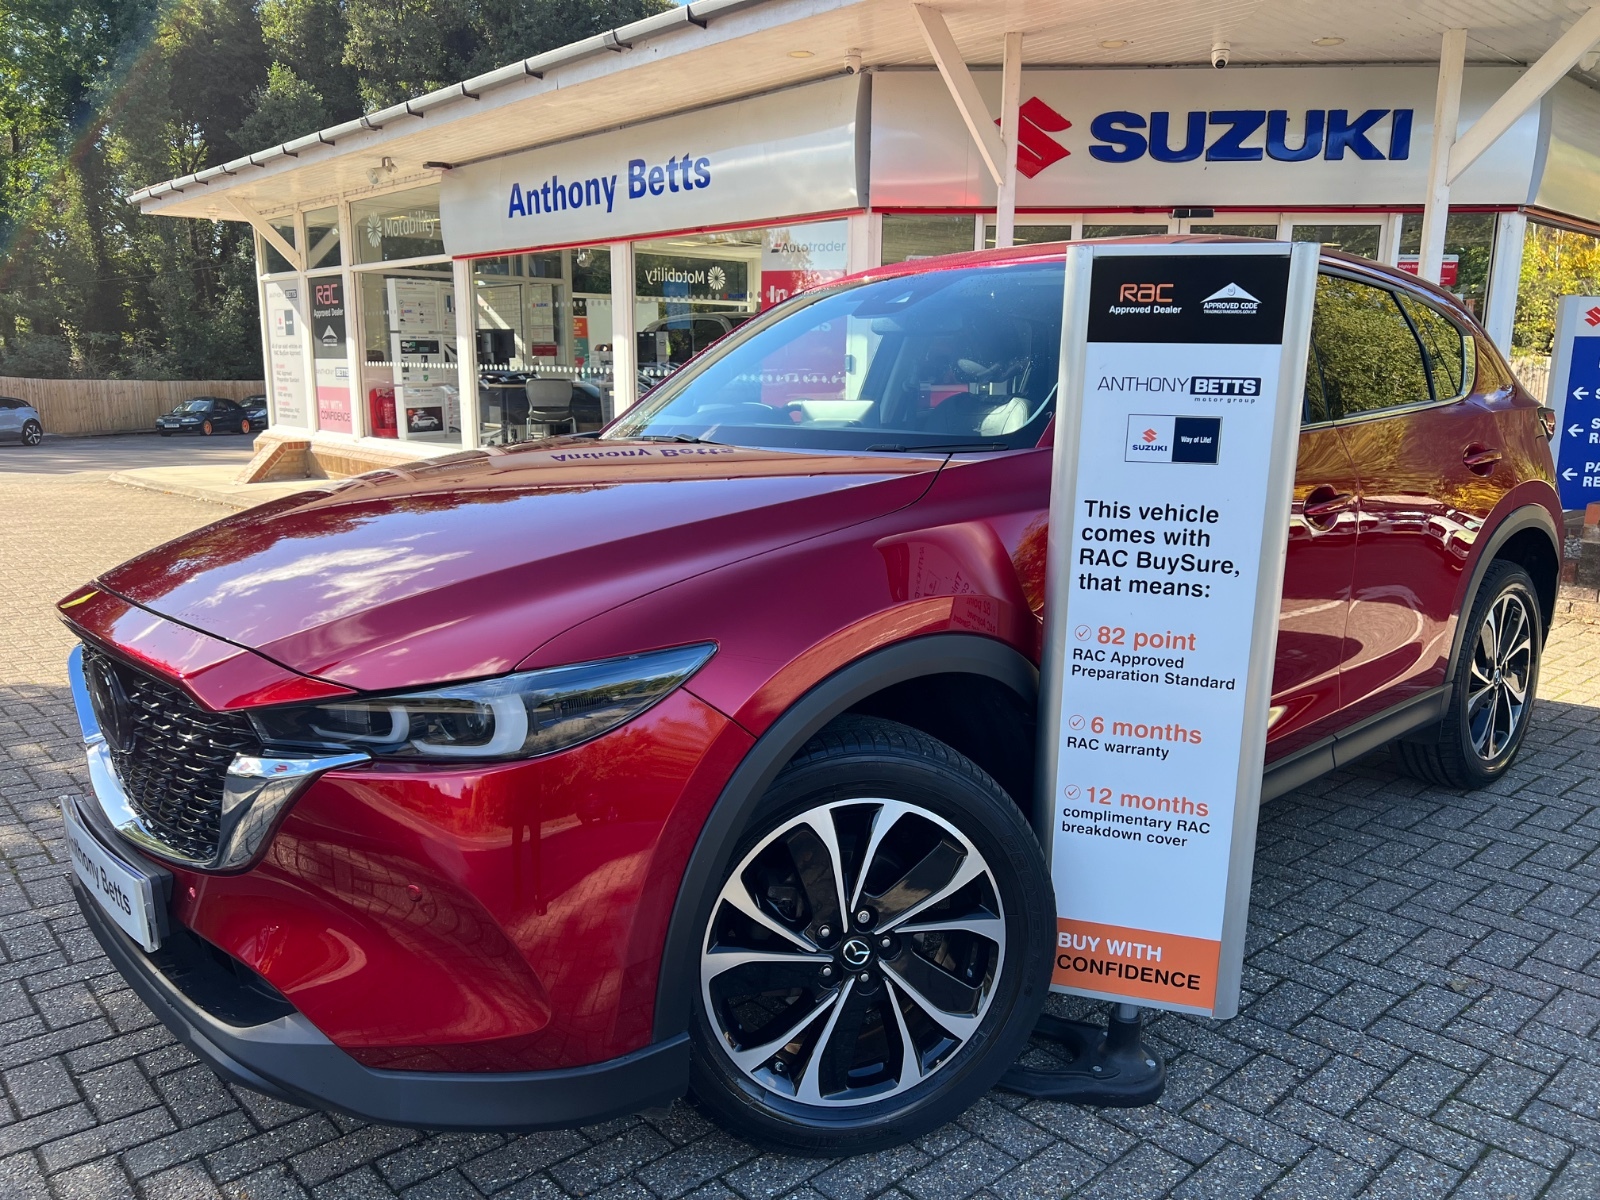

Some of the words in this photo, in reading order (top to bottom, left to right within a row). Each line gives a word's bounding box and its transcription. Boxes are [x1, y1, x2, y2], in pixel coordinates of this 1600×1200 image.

[1089, 108, 1413, 163] SUZUKI
[508, 175, 617, 218] Anthony
[628, 152, 711, 199] Betts
[384, 210, 436, 238] Motability
[781, 241, 846, 253] Autotrader
[1119, 284, 1174, 303] RAC
[1109, 305, 1150, 315] Approved
[1153, 305, 1182, 314] Dealer
[1097, 376, 1189, 392] ANTHONY
[1194, 379, 1257, 394] BETTS
[1180, 436, 1192, 444] Way
[1589, 432, 1600, 444] R
[1084, 500, 1131, 519] This
[1138, 503, 1219, 523] vehicle
[1081, 527, 1155, 544] comes
[1163, 528, 1210, 547] with
[1079, 548, 1128, 567] RAC
[1136, 551, 1240, 577] BuySure,
[1079, 573, 1122, 591] that
[1128, 579, 1210, 598] means:
[1097, 625, 1126, 645] 82
[1133, 630, 1197, 651] point
[1072, 648, 1106, 662] RAC
[1110, 651, 1184, 669] Approved
[1071, 664, 1159, 683] Preparation
[1164, 672, 1236, 690] Standard
[1090, 716, 1104, 734] 6
[1112, 720, 1202, 745] months
[1067, 736, 1099, 751] RAC
[1104, 741, 1169, 761] warranty
[1086, 786, 1113, 805] 12
[1120, 792, 1209, 817] months
[1062, 807, 1172, 832] complimentary
[1176, 819, 1211, 834] RAC
[1061, 821, 1142, 842] breakdown
[1146, 833, 1188, 847] cover
[100, 866, 131, 916] Betts
[1057, 931, 1100, 952] BUY
[1106, 938, 1162, 963] WITH
[1057, 954, 1201, 991] CONFIDENCE
